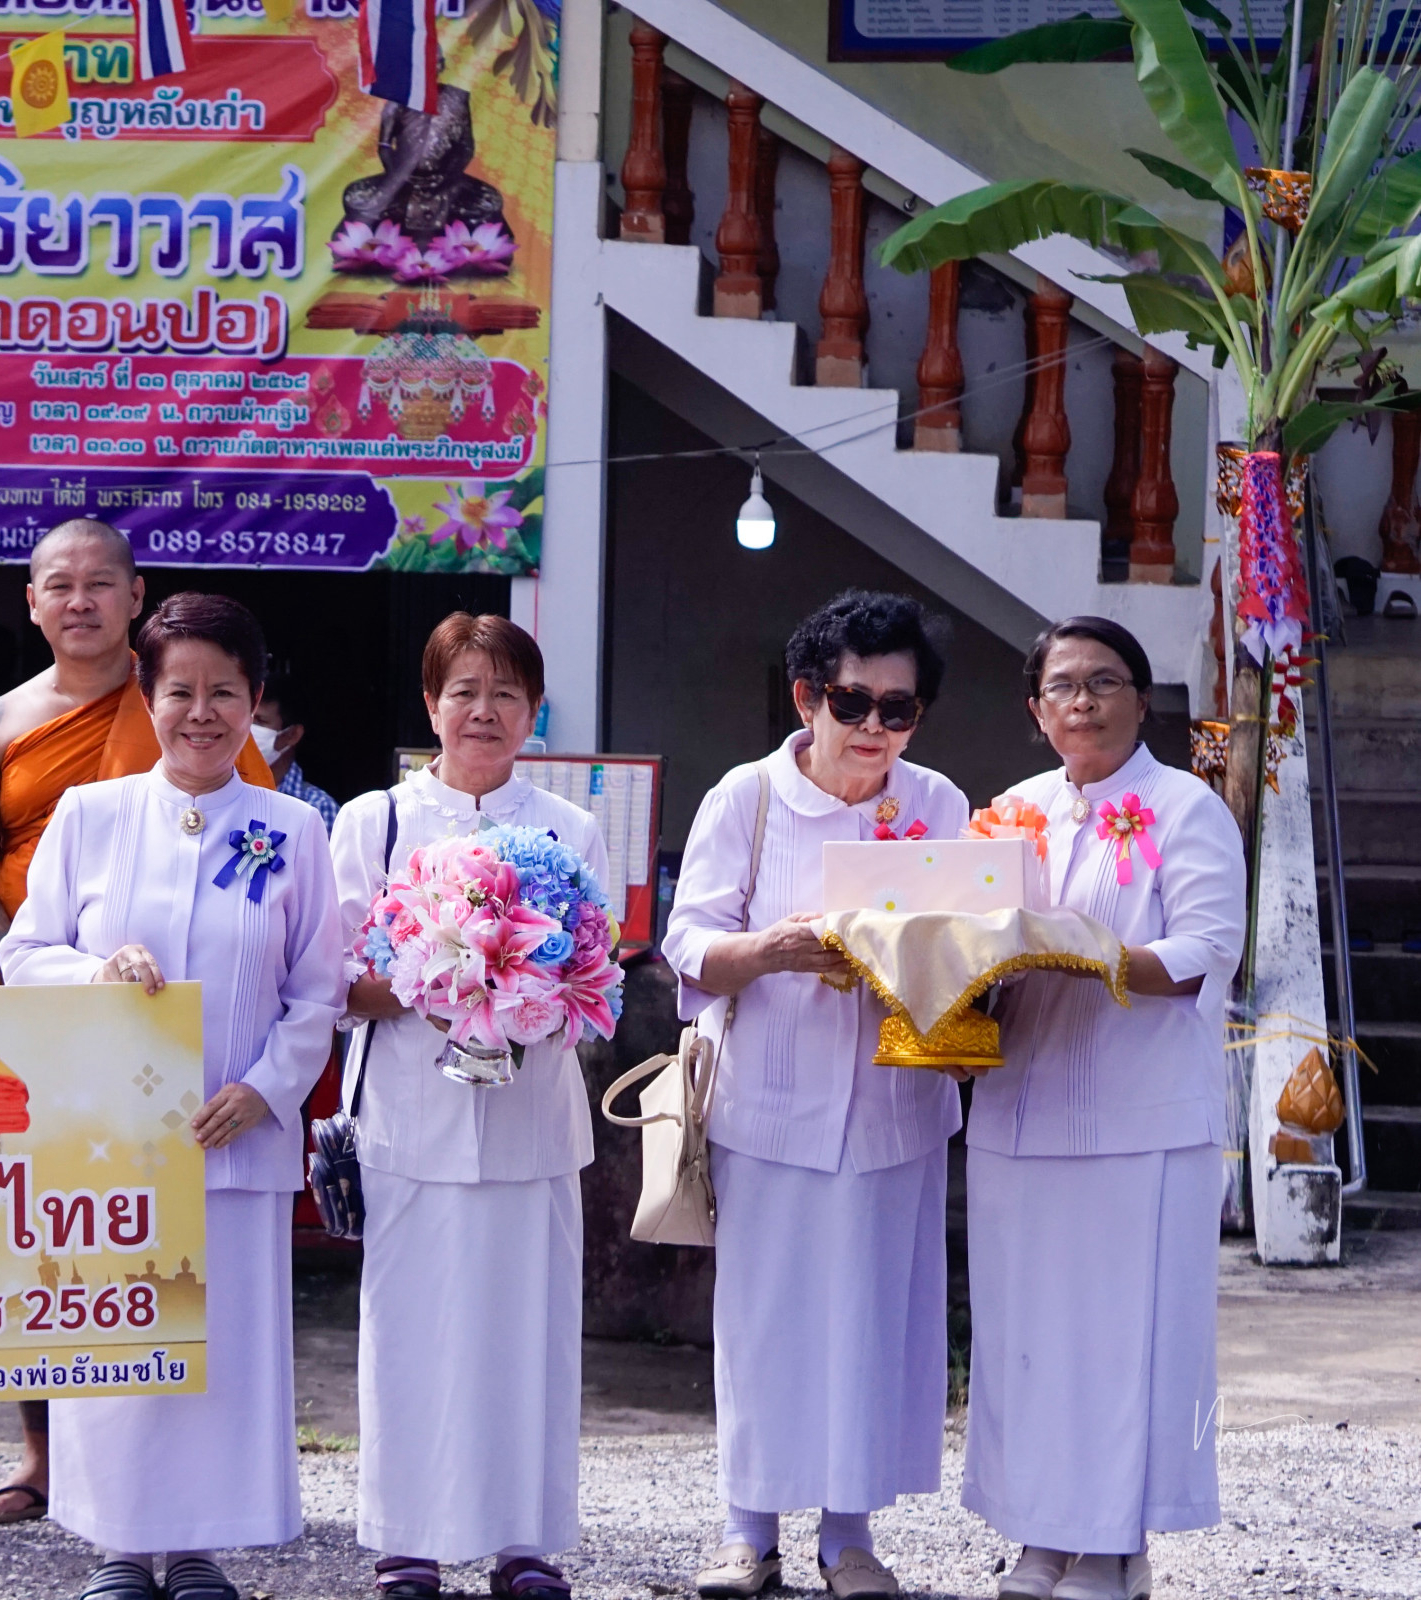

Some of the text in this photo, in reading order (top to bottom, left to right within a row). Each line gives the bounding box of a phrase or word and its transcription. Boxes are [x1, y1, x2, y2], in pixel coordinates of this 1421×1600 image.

[14, 41, 130, 80] าท
[32, 364, 107, 388] วันเสาร์
[114, 361, 131, 387] ที่
[174, 371, 244, 398] ตุลาคม
[32, 402, 78, 421] เวลา
[159, 405, 183, 423] น.
[187, 400, 309, 430] ถวายผ้ากฐิน
[32, 434, 78, 454] เวลา
[157, 437, 180, 456] น.
[183, 435, 524, 468] ถวายภัตตาหารเพลแด่พระภิกษุสงฆ์
[192, 480, 225, 509] โทร
[235, 491, 367, 513] 084-1959262
[148, 529, 347, 556] 089-8578847
[25, 1285, 156, 1331] 2568
